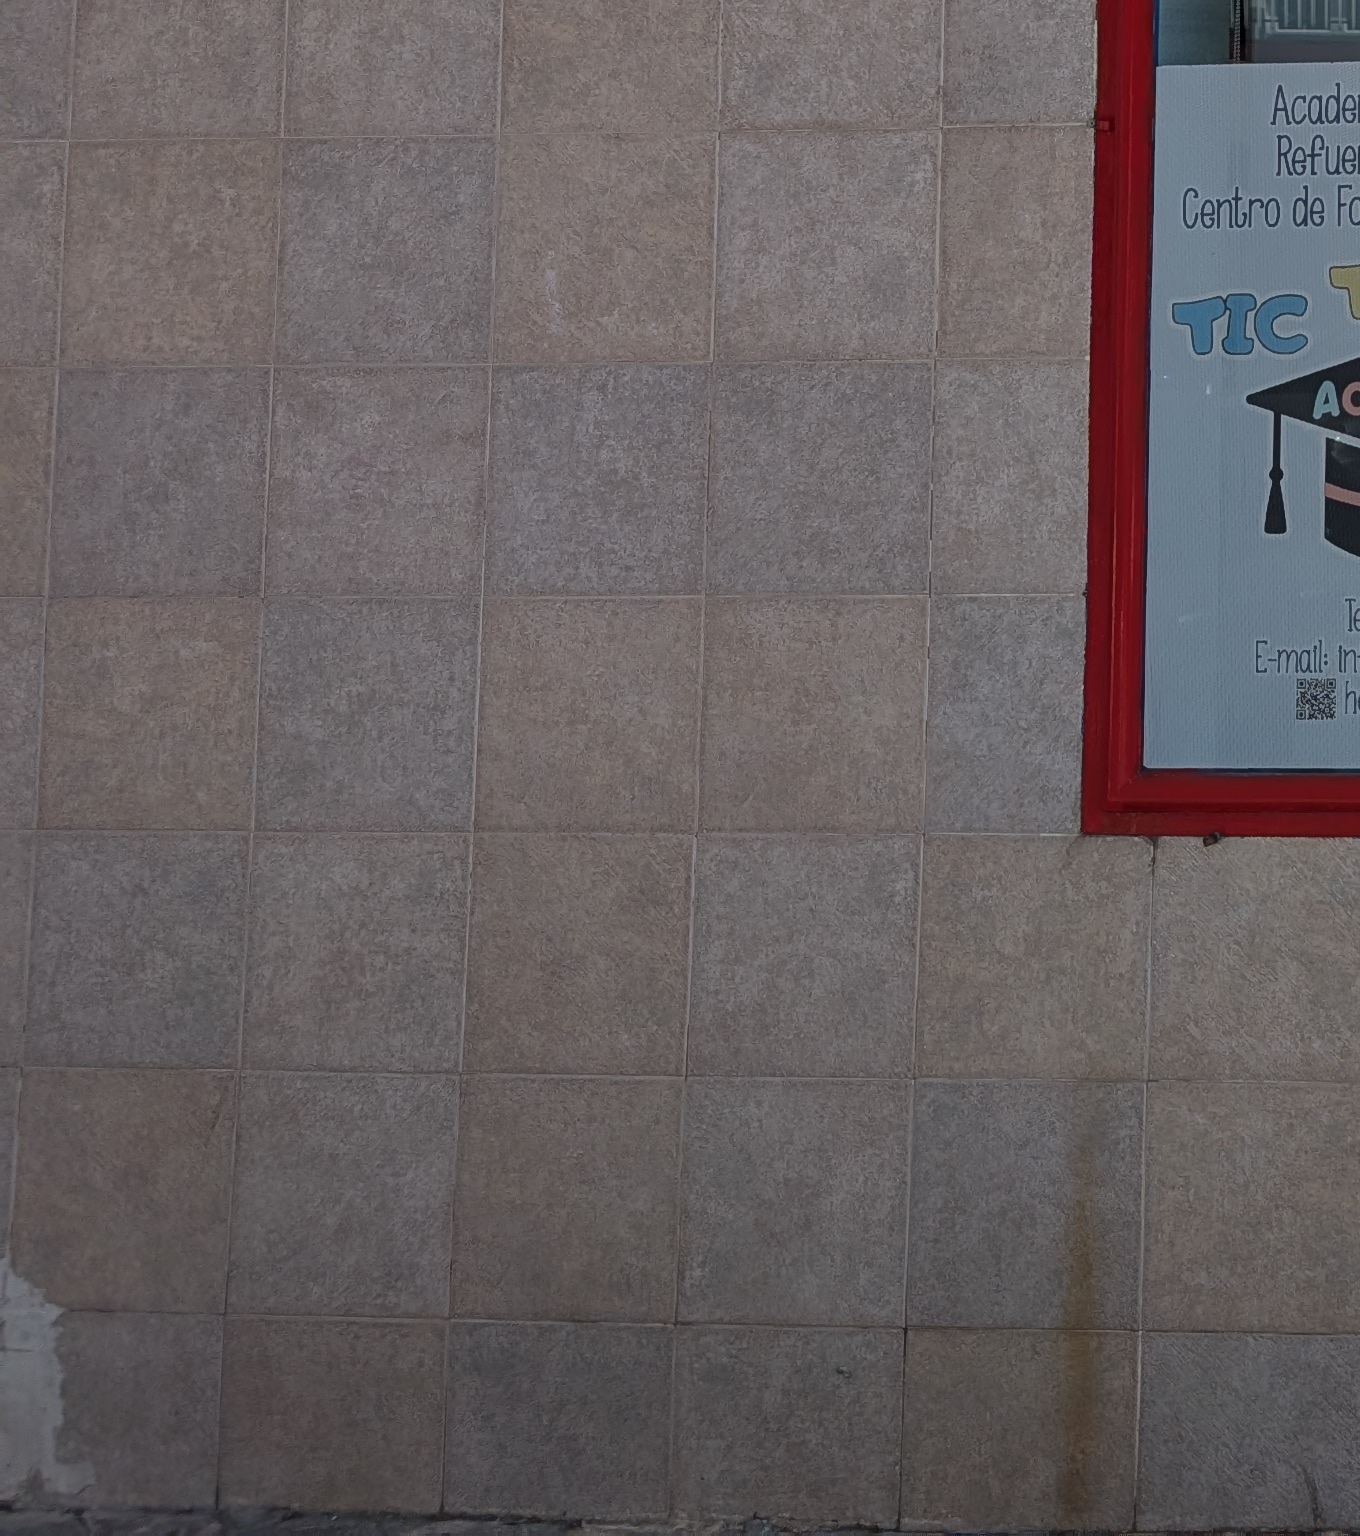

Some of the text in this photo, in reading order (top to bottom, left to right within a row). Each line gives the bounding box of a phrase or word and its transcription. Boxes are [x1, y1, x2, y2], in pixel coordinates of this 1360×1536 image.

[1182, 186, 1280, 229] Centro
[1292, 185, 1325, 227] de
[1172, 293, 1308, 355] TIC
[1255, 640, 1329, 674] E-mail:
